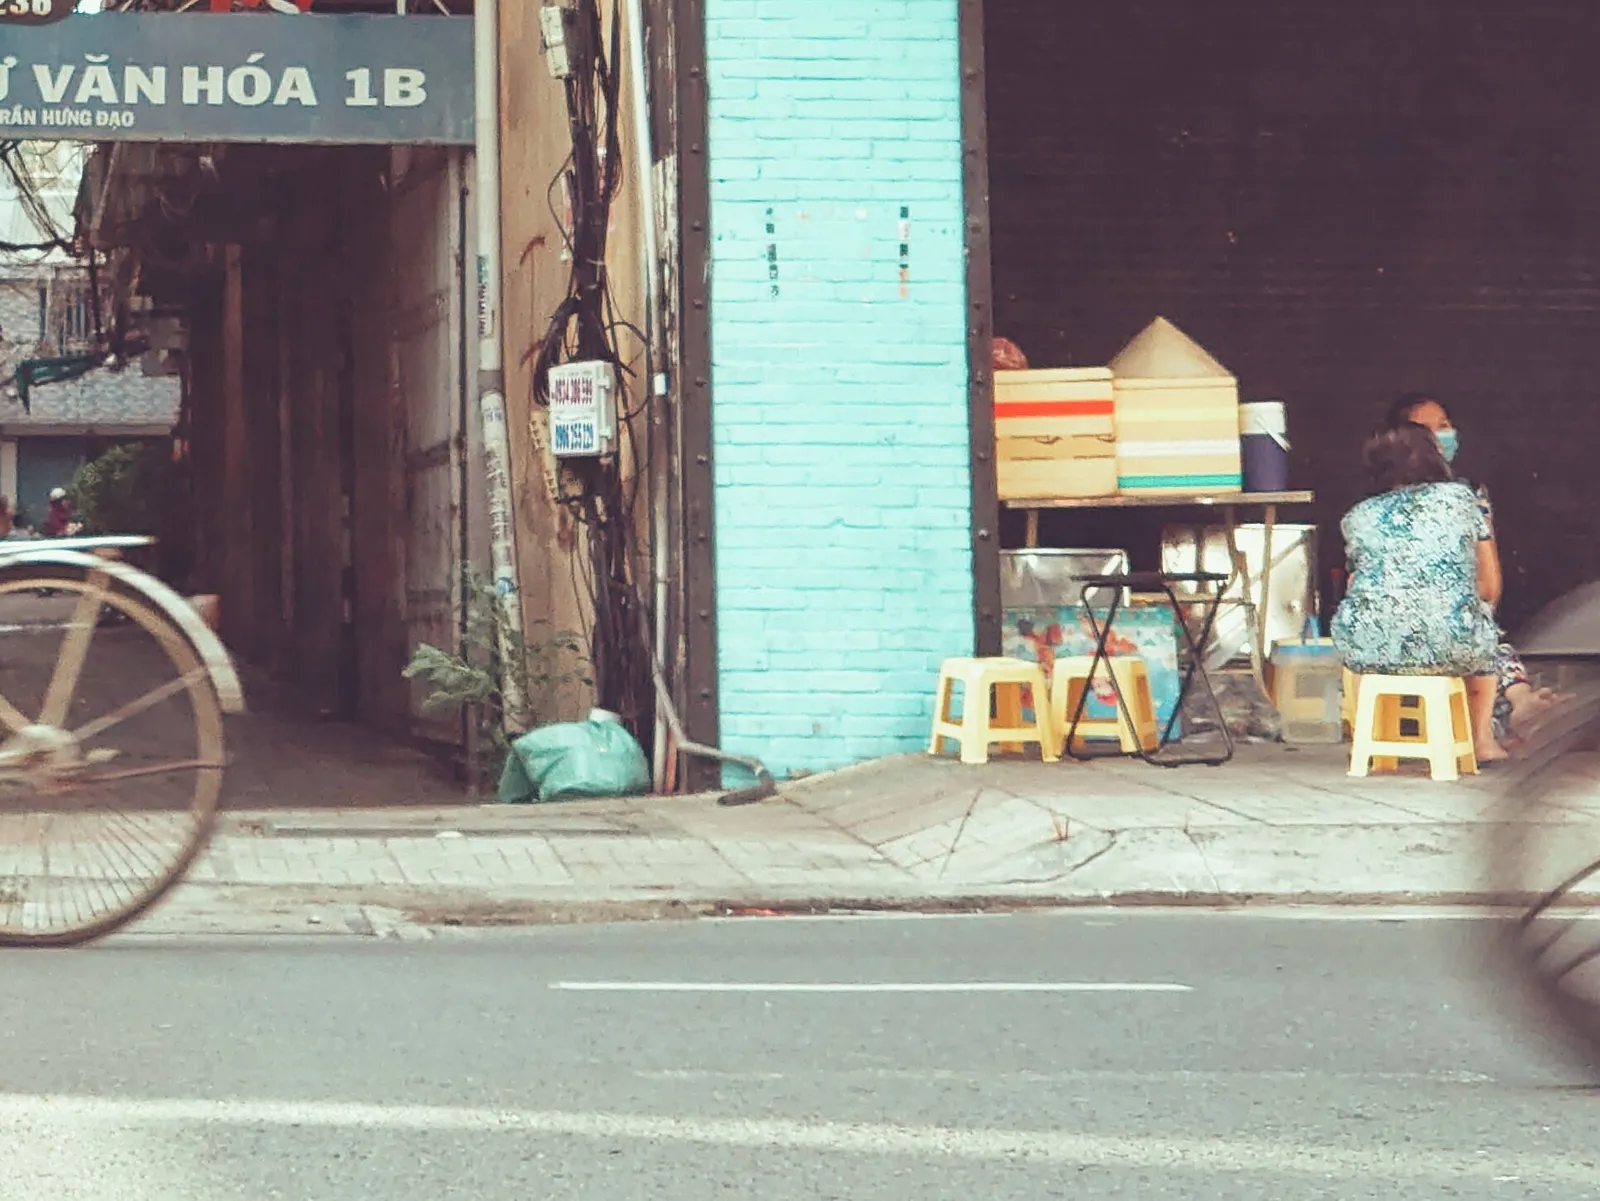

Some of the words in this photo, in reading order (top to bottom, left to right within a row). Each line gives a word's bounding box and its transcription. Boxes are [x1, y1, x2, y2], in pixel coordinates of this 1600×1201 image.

[32, 53, 167, 104] VĂN
[183, 52, 318, 106] HÓA
[344, 67, 428, 107] 1B
[41, 106, 92, 127] HƯNG
[96, 109, 135, 131] ĐẠO
